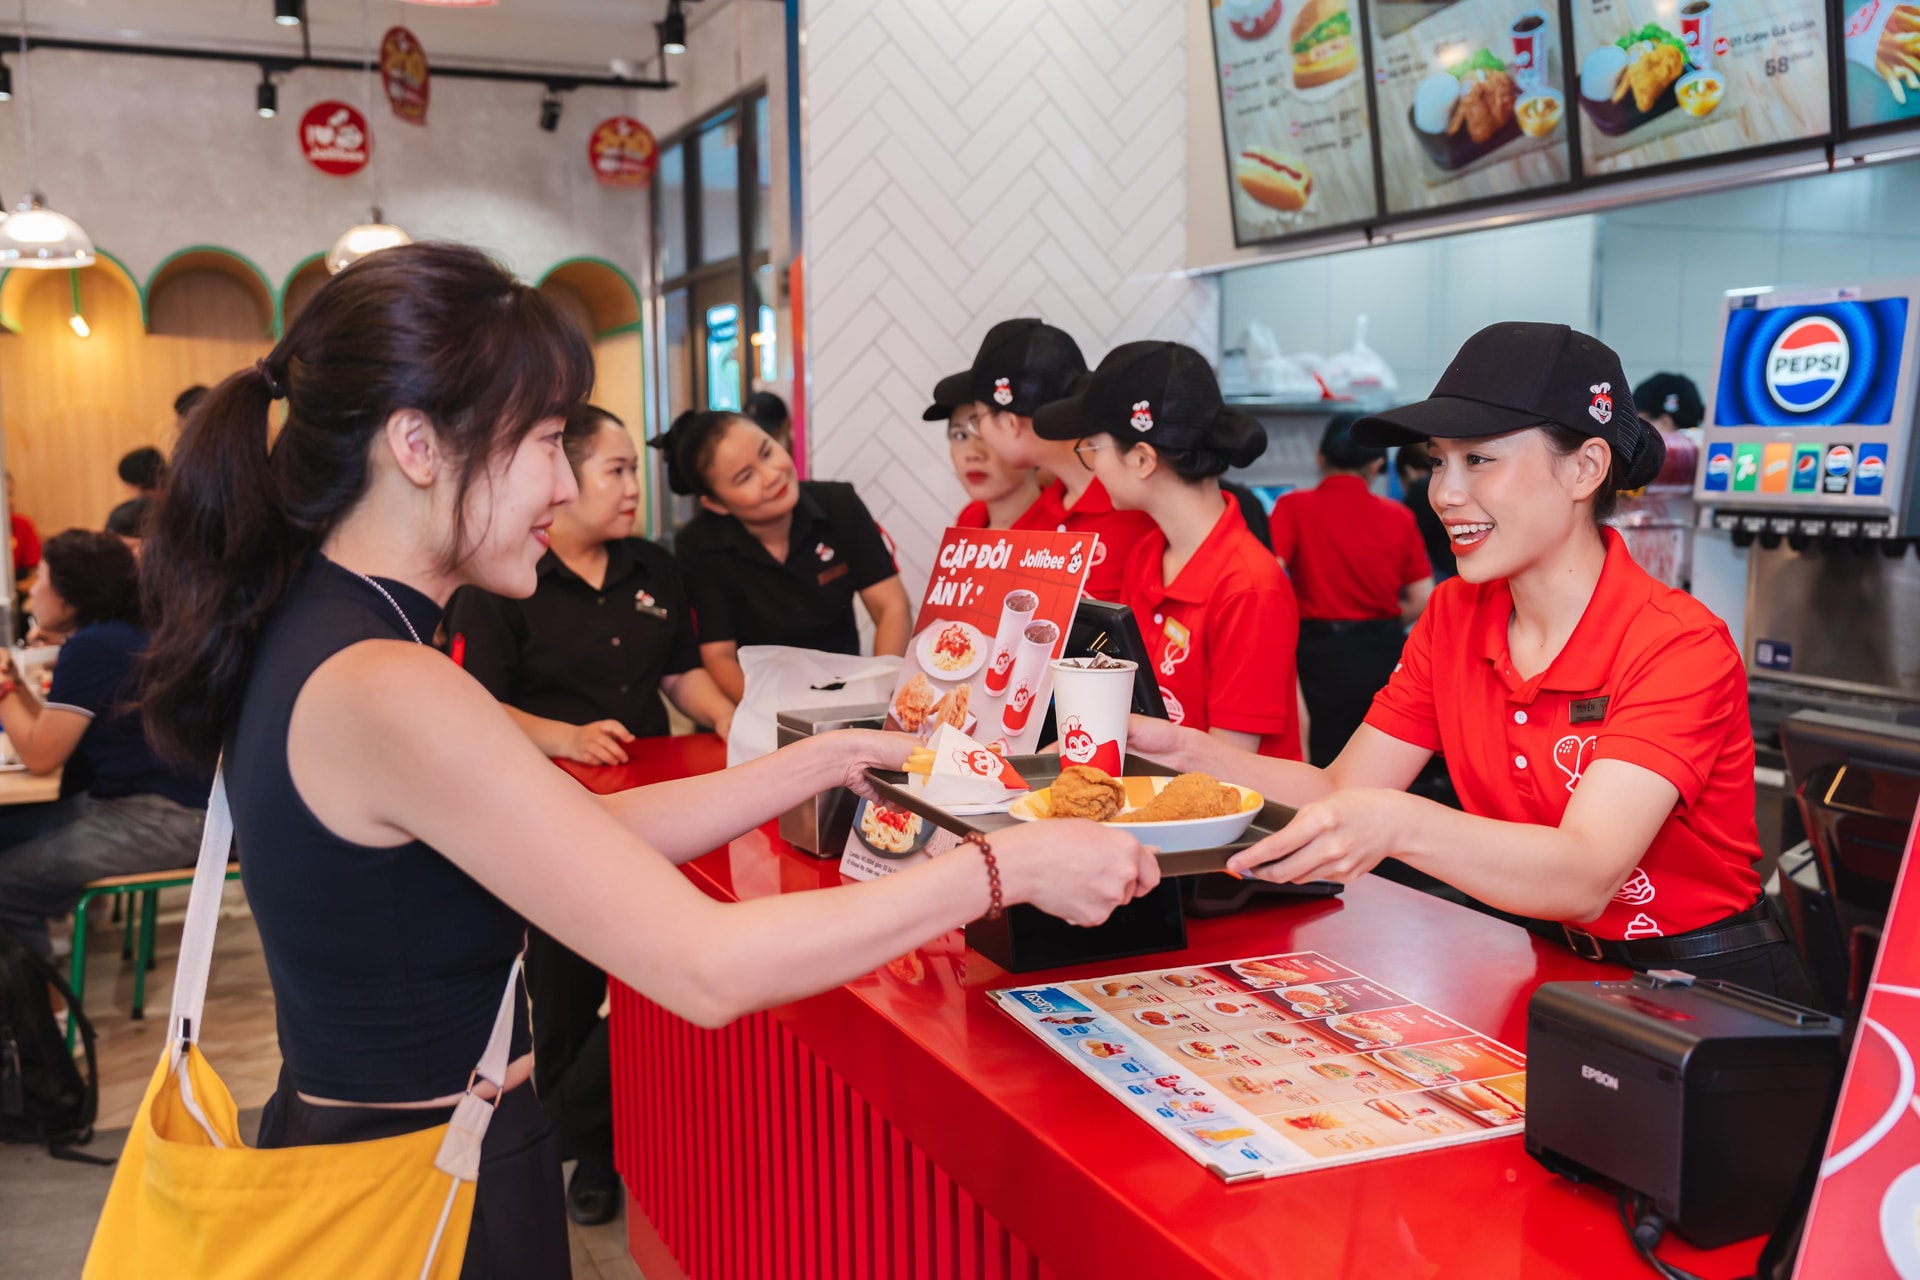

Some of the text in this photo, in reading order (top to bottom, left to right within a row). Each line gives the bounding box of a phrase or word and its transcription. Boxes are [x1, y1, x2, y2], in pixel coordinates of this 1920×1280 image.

[1775, 355, 1841, 373] PEPSI
[940, 538, 1013, 576] CẶP ĐÔI
[1019, 548, 1066, 570] Jollibee
[927, 576, 958, 606] ĂN
[1582, 1064, 1619, 1090] EPSON
